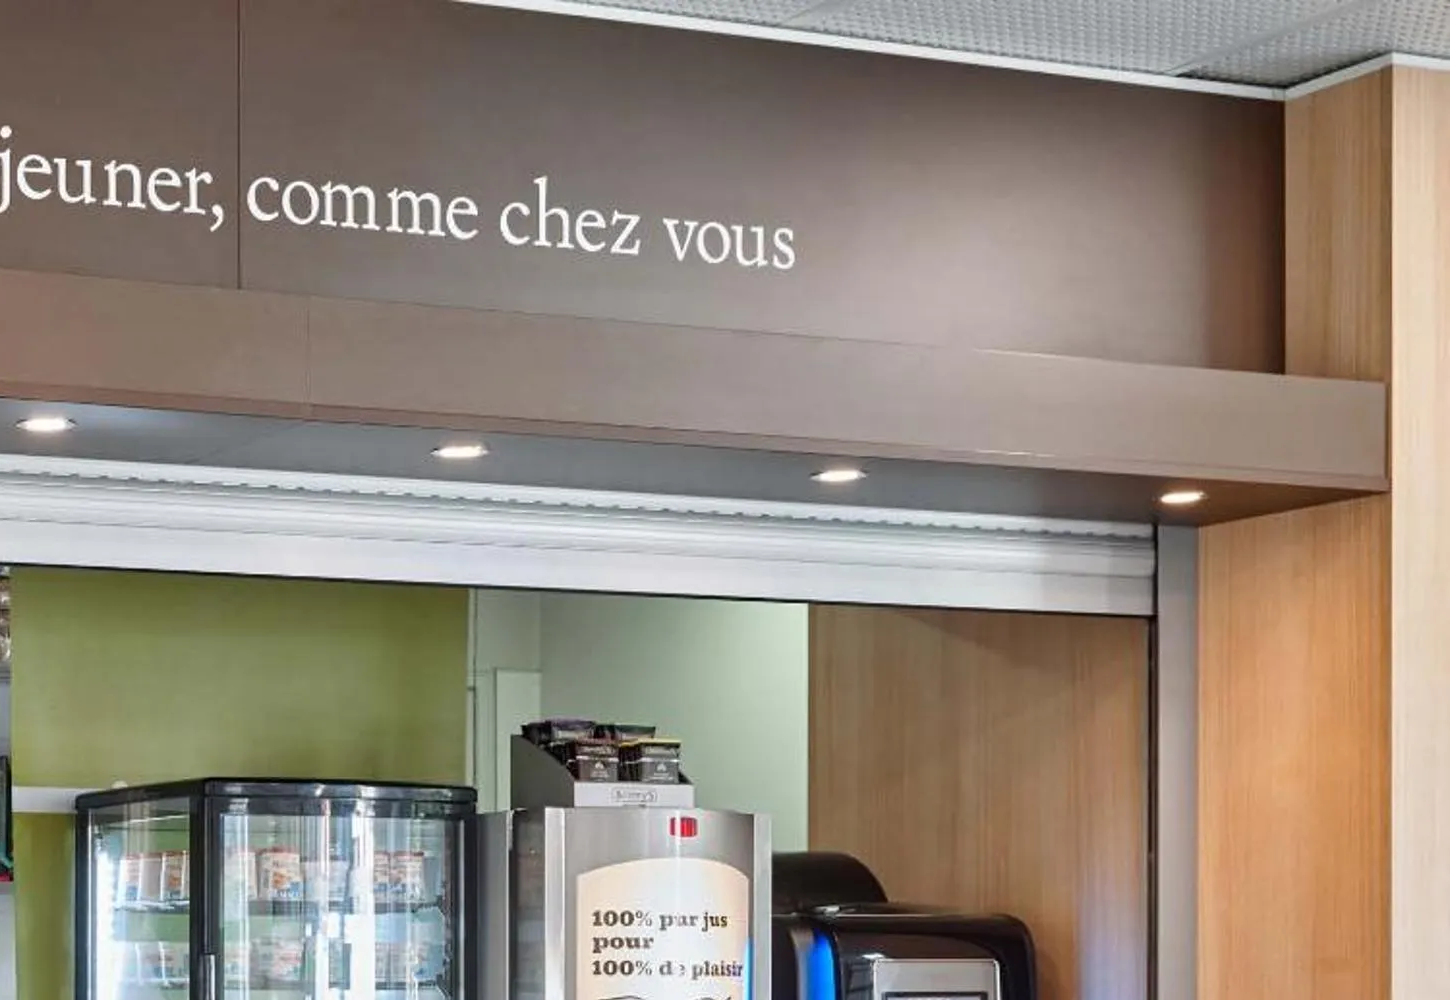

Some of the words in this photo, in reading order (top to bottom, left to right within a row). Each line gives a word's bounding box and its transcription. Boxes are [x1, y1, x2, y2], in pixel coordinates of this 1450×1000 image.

[246, 176, 479, 241] comme
[499, 175, 642, 256] chez
[662, 217, 797, 270] vous
[592, 910, 653, 927] 100%
[702, 911, 728, 932] jus
[592, 936, 654, 954] pour
[592, 960, 653, 976] 100%
[691, 960, 744, 981] plaisir
